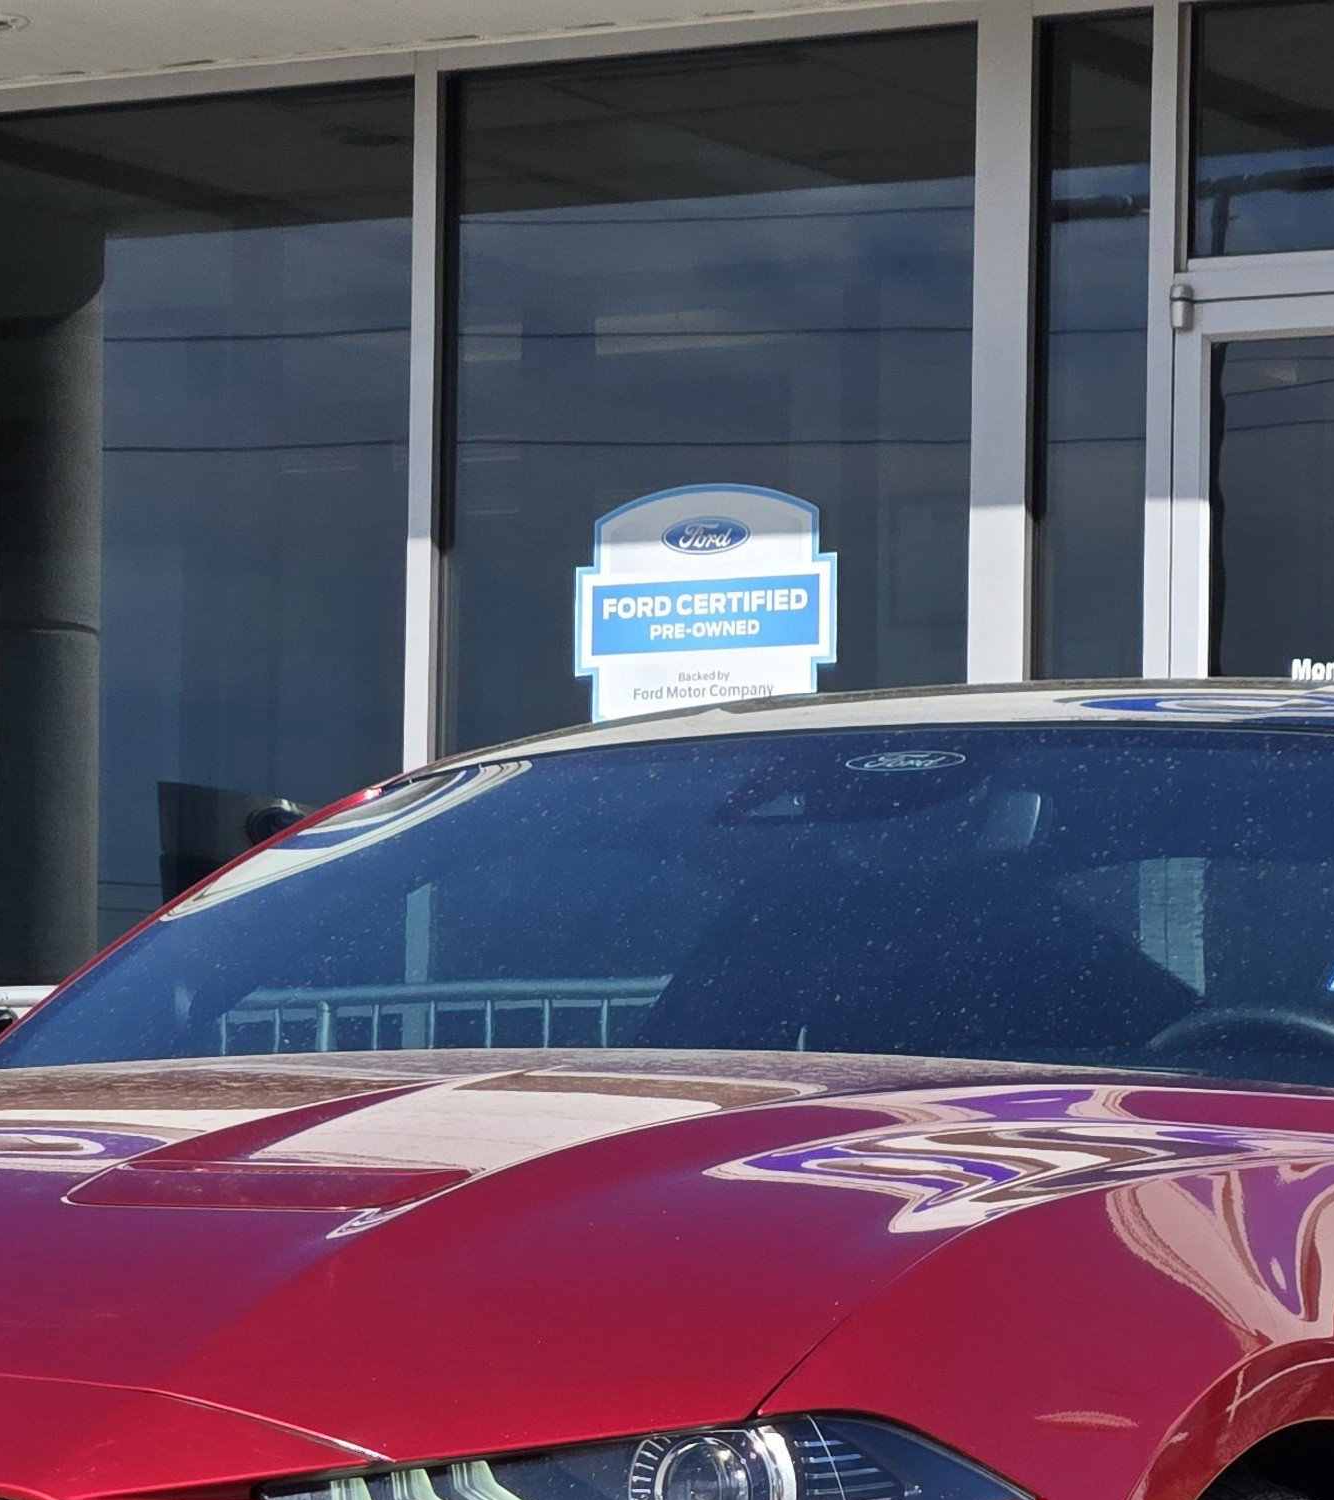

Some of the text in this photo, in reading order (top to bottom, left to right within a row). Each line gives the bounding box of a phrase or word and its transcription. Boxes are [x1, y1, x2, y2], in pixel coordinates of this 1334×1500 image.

[678, 522, 733, 549] Ford
[602, 588, 808, 620] FORD CERTIFIED
[650, 619, 760, 640] PRE-OWNED
[678, 670, 730, 682] Backed by
[633, 683, 774, 700] Ford Motor Company
